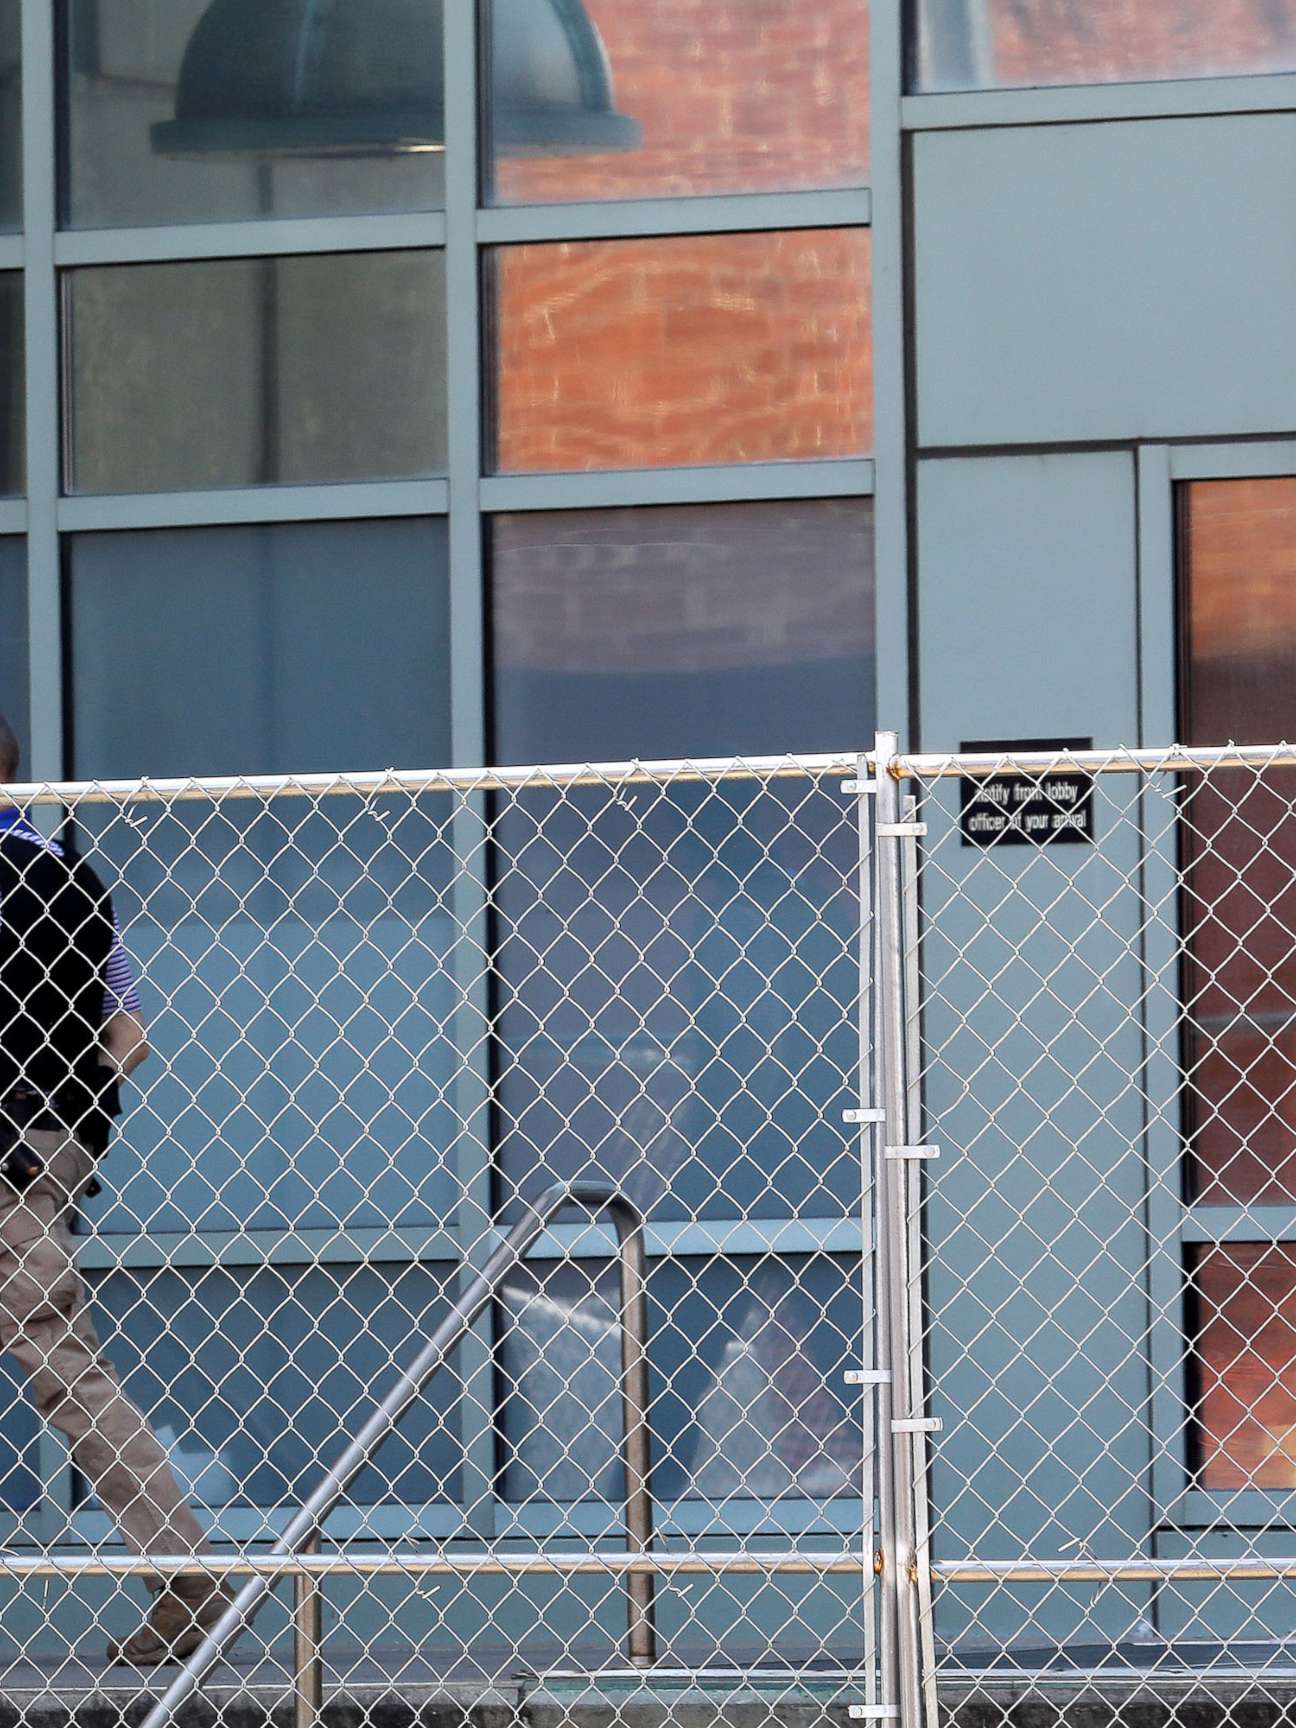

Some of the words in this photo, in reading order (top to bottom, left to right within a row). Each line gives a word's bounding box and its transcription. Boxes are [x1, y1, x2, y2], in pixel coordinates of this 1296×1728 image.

[975, 783, 1010, 805] notify
[1045, 781, 1078, 803] lobby
[968, 812, 1006, 831] officer
[1024, 814, 1049, 833] your
